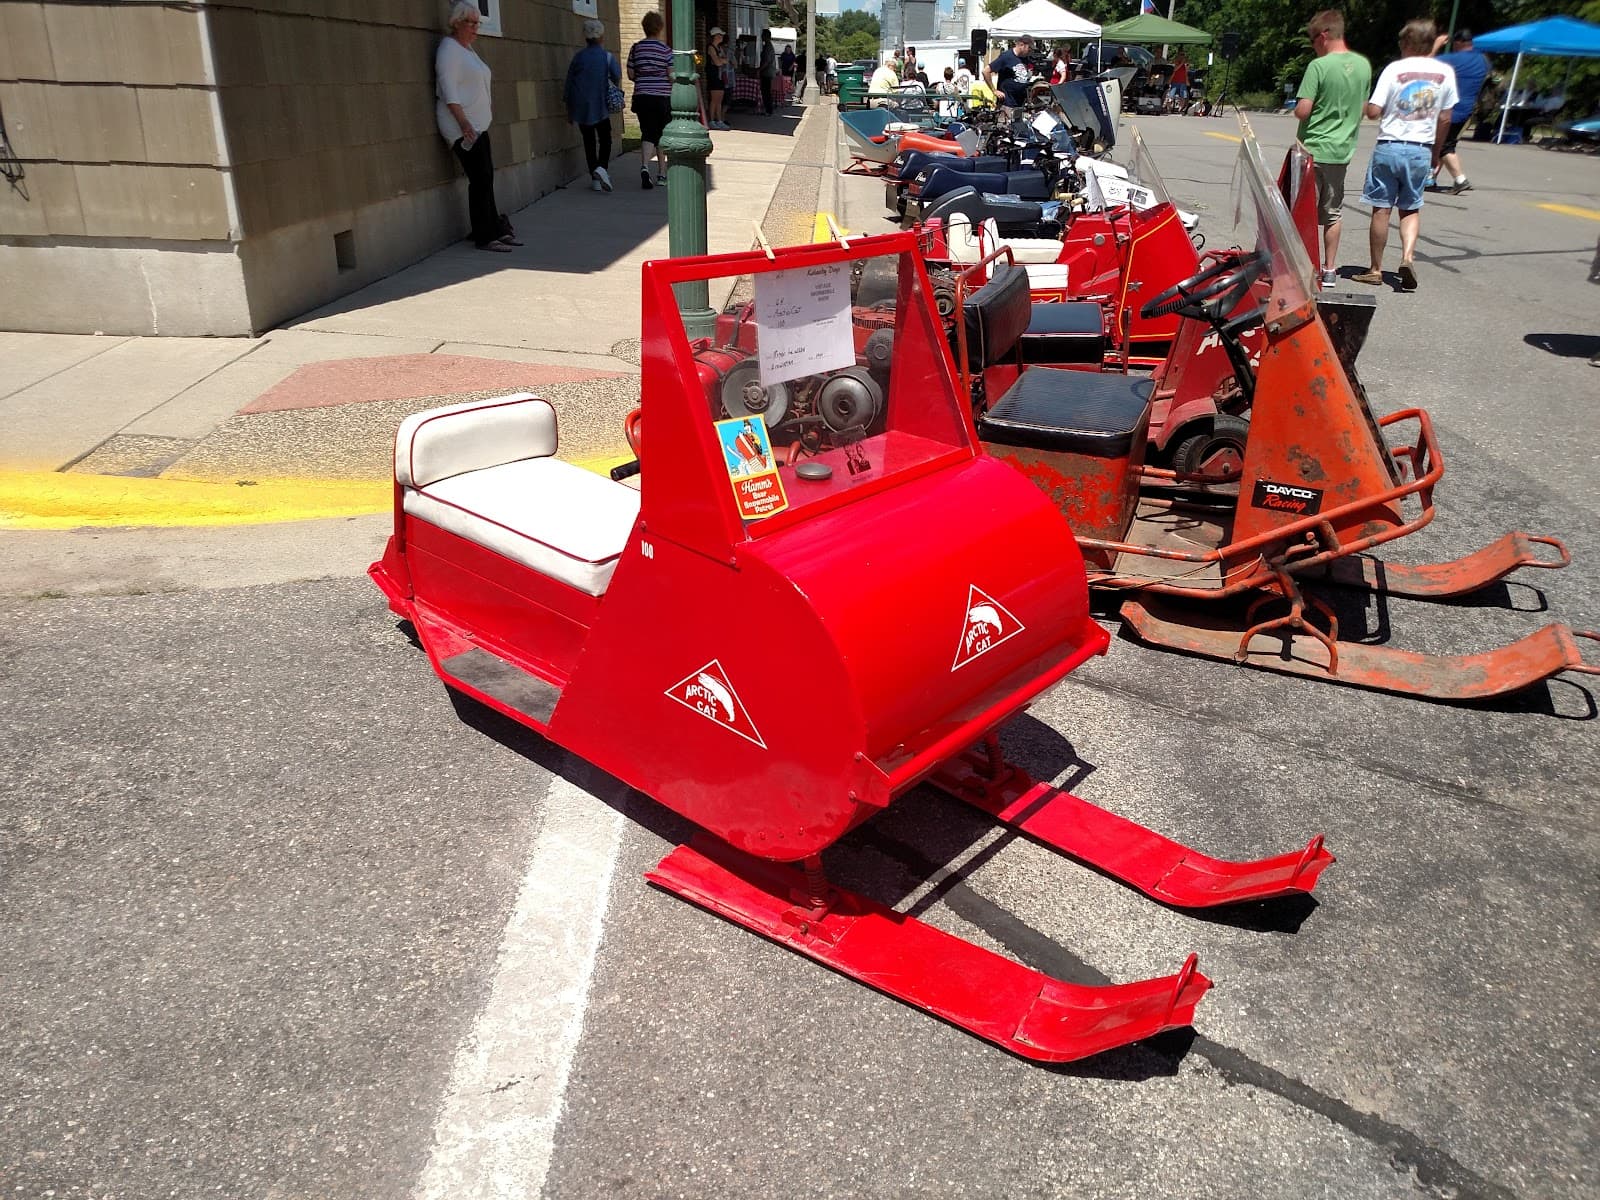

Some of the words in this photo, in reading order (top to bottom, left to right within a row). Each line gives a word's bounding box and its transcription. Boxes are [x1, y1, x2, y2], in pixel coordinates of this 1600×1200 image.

[1127, 188, 1147, 204] 15
[1264, 485, 1314, 499] DAYCO
[744, 496, 779, 508] Snowmobile
[755, 504, 774, 513] Patrol
[1263, 494, 1306, 512] Racing
[641, 540, 654, 559] 100
[966, 622, 989, 655] ARCTIC
[976, 636, 991, 652] CAT
[685, 685, 716, 706] ARCTIC
[697, 701, 717, 718] CAT
